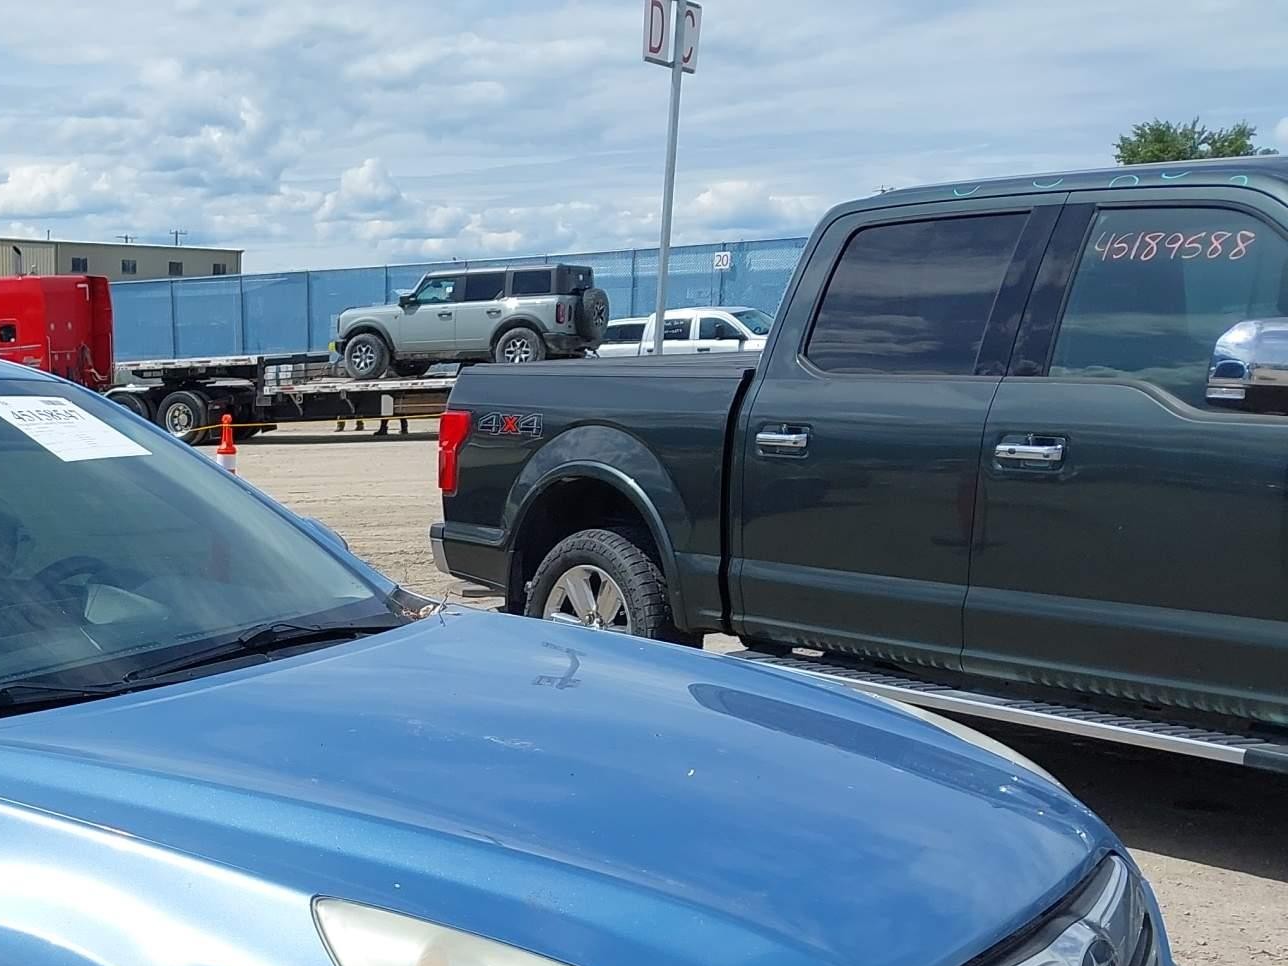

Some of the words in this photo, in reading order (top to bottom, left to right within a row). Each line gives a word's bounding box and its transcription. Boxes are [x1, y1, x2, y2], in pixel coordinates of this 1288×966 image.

[648, 0, 665, 54] D
[1094, 230, 1256, 262] 45189588
[714, 254, 729, 267] 20
[10, 409, 86, 422] 45158547
